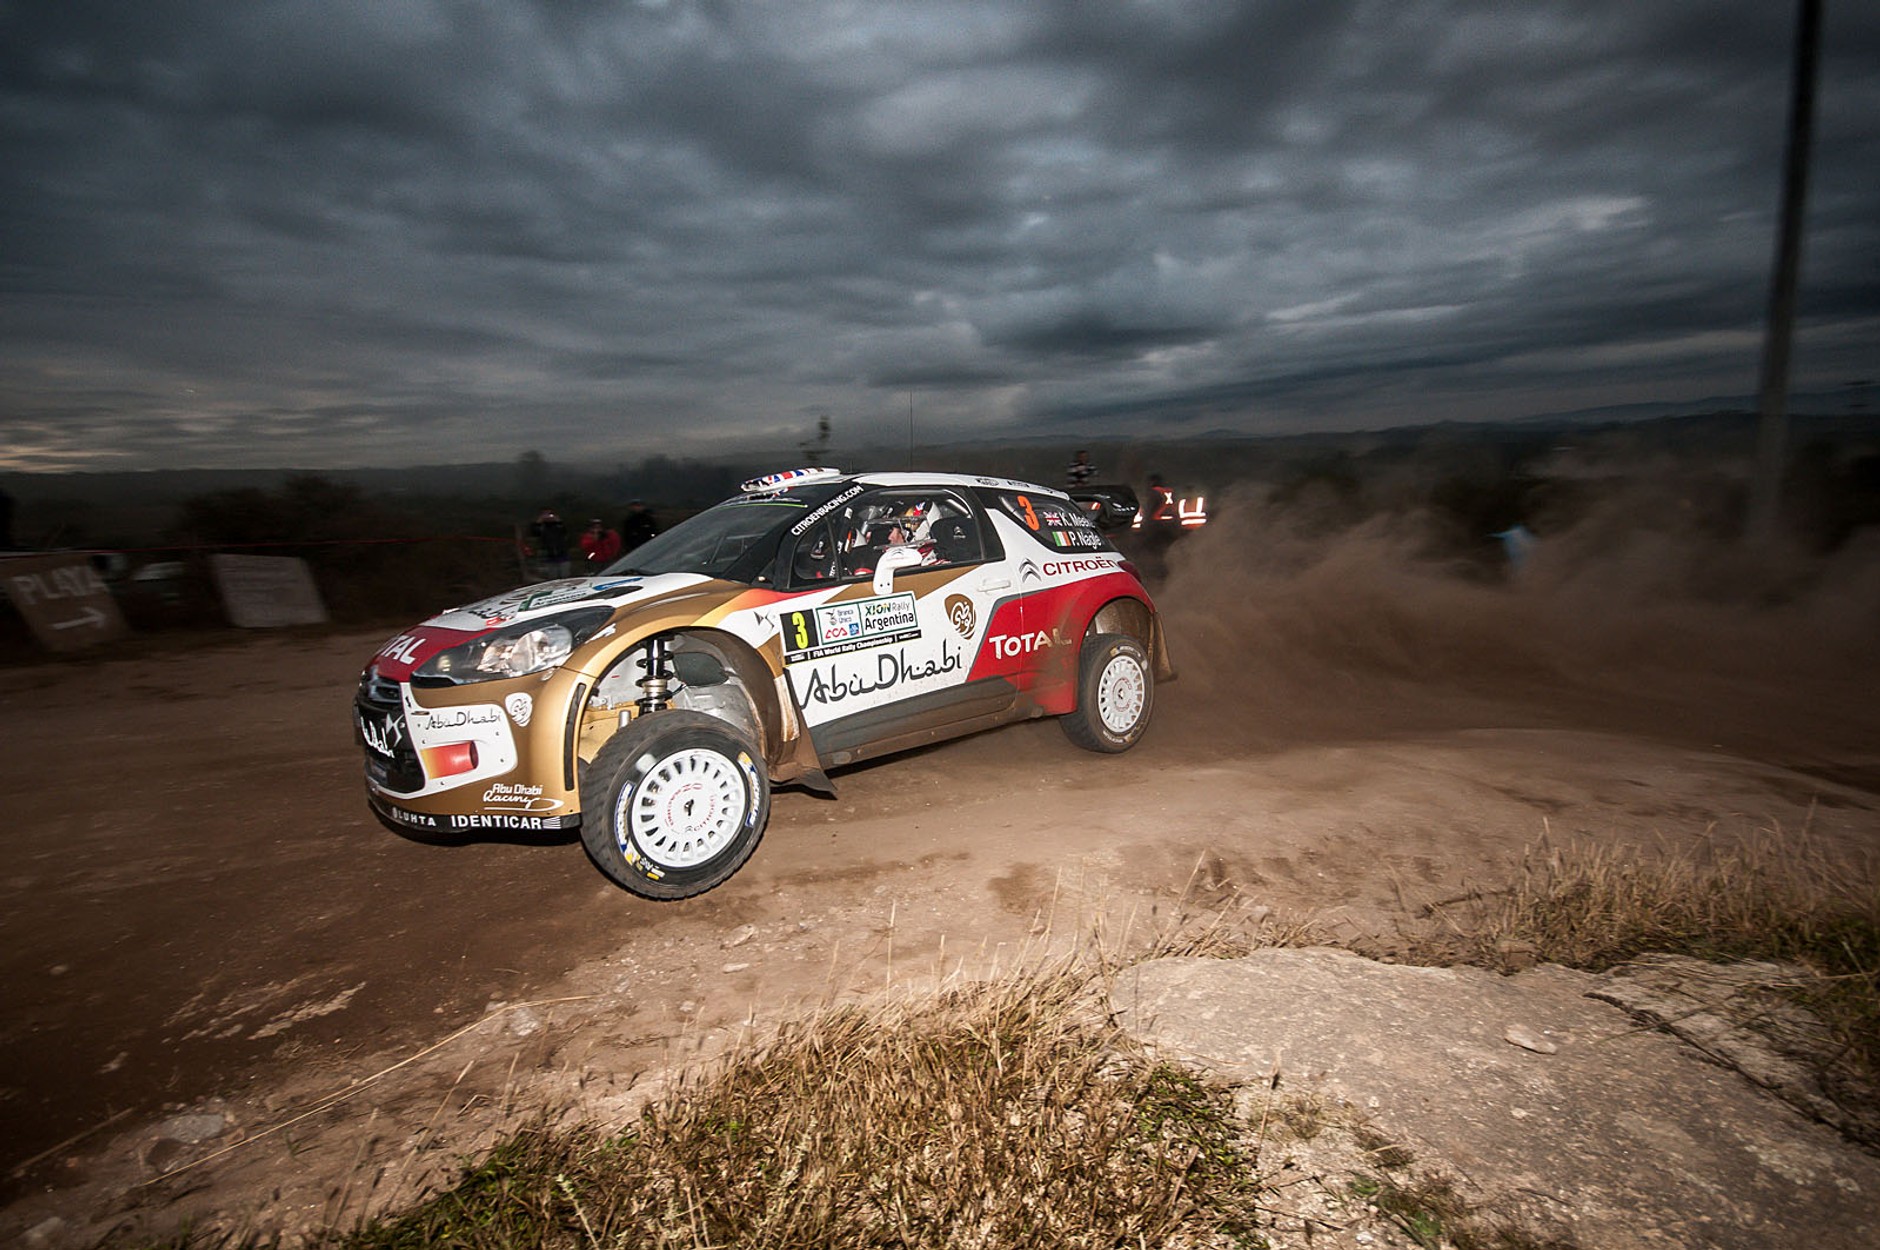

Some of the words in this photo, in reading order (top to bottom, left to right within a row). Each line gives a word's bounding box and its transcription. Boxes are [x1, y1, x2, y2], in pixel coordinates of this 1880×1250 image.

[791, 485, 865, 537] CITROENRACING.COM
[1017, 495, 1040, 531] 3
[891, 601, 911, 612] Rally
[792, 612, 809, 650] 3
[865, 612, 915, 631] Argentina
[989, 628, 1073, 660] TOTAL
[492, 783, 512, 794] Abu
[513, 783, 544, 795] Dhabi
[451, 814, 542, 830] IDENTICAR
